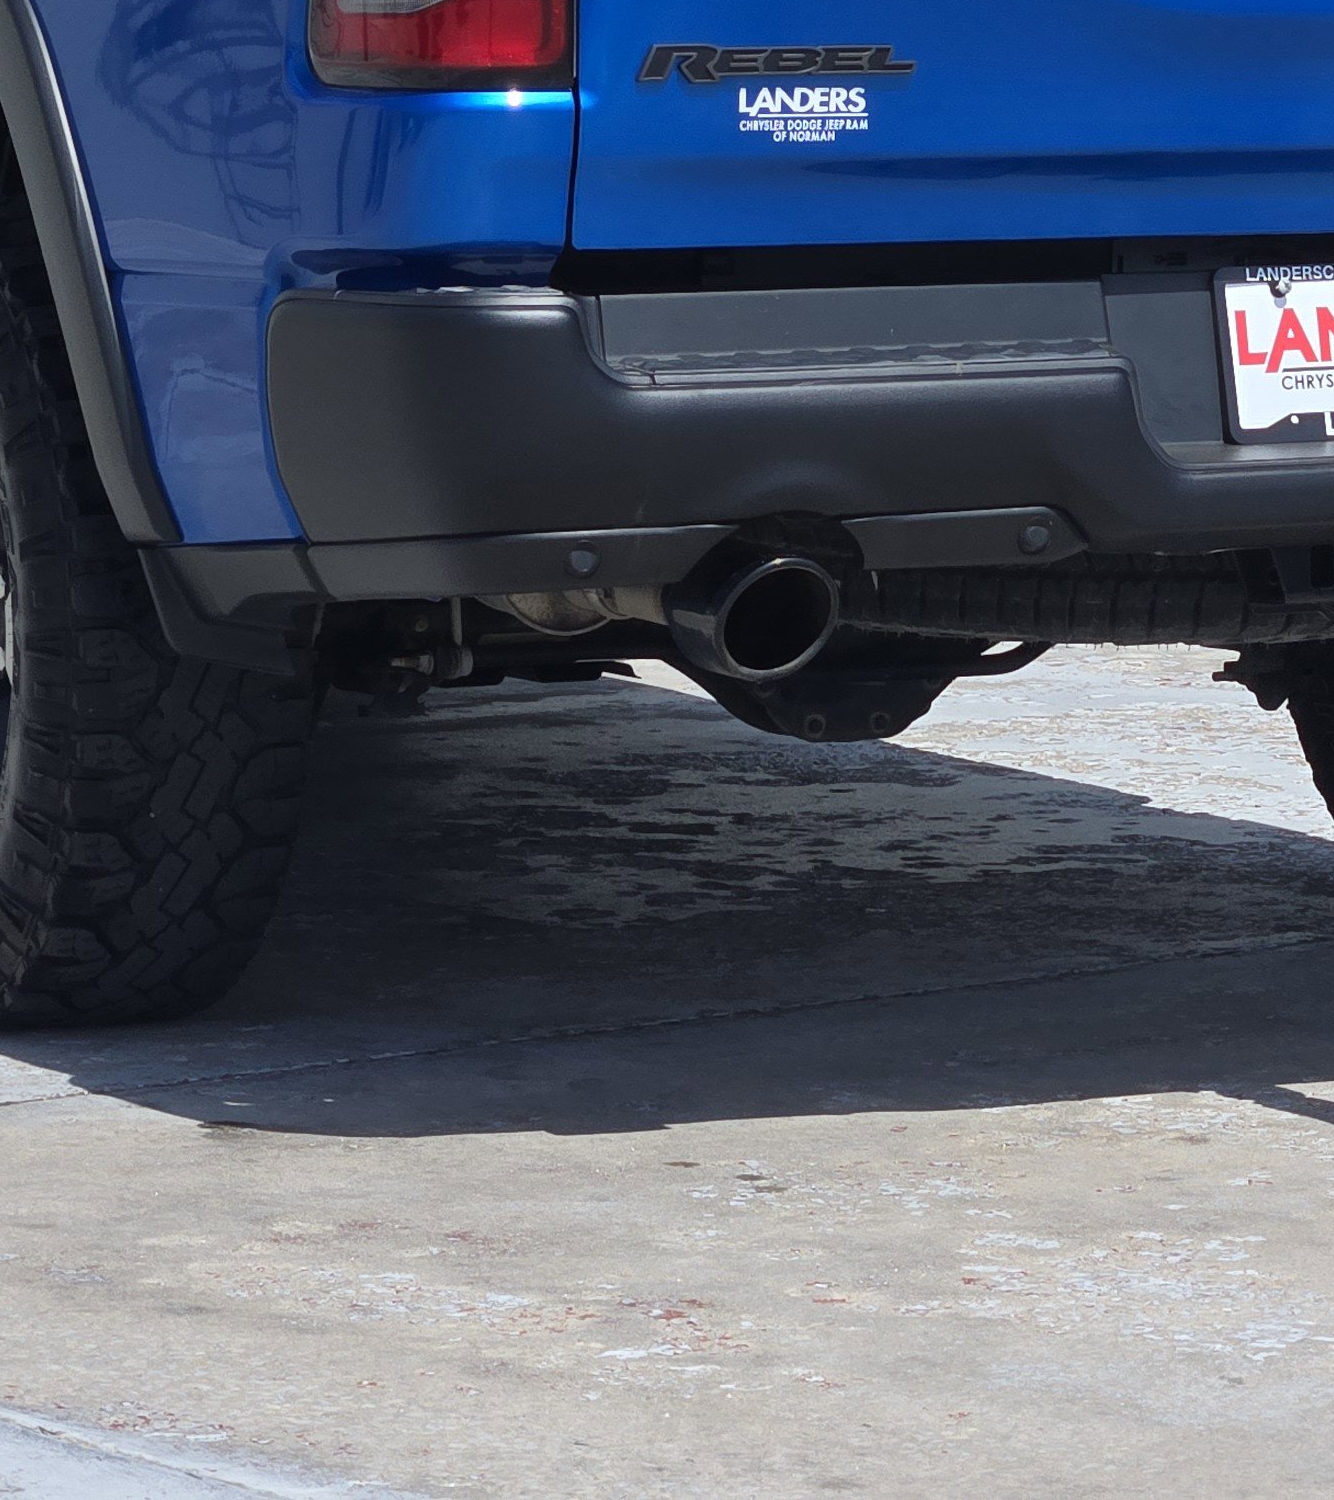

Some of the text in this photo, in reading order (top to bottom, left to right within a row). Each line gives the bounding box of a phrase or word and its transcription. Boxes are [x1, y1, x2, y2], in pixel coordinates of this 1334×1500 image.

[637, 43, 916, 83] REBEL
[738, 87, 866, 116] LANDERS
[739, 119, 868, 131] CHRYSLER DODGE JEEP RAM
[772, 131, 836, 142] OF NORMAN
